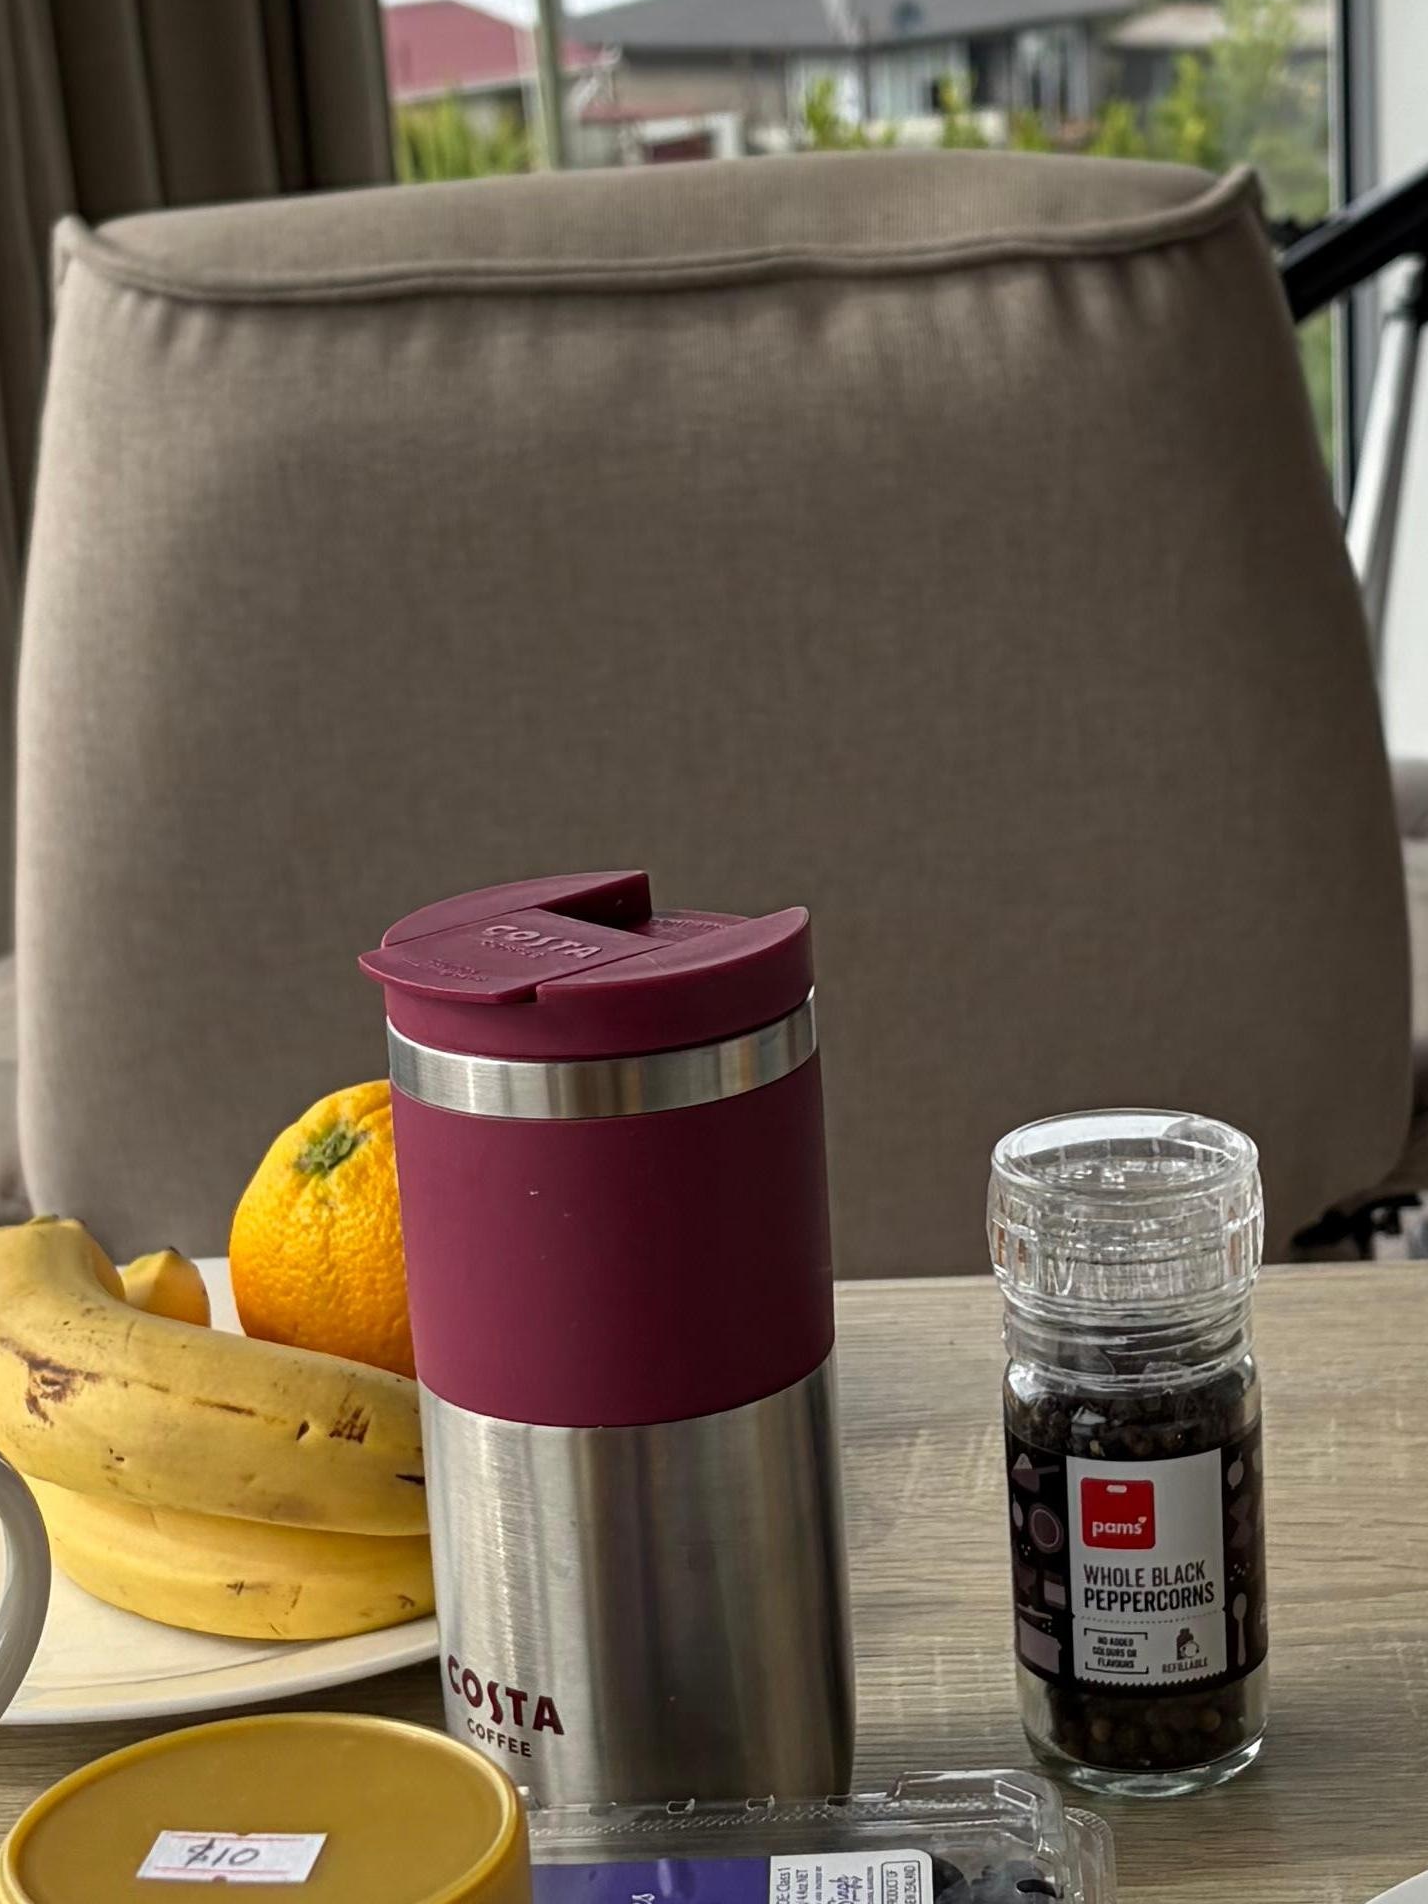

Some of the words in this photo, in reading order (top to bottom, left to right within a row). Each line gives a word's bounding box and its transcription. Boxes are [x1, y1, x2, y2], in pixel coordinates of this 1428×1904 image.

[481, 924, 603, 960] COSTA
[1091, 1520, 1144, 1538] pams
[1083, 1563, 1146, 1588] WHOLE
[1151, 1559, 1206, 1588] BLACK
[1083, 1581, 1215, 1613] PEPPERCORNS
[1162, 1656, 1208, 1674] REFILLABLE
[447, 1654, 565, 1736] COSTA
[467, 1717, 532, 1757] COFFEE
[184, 1837, 260, 1867] $10
